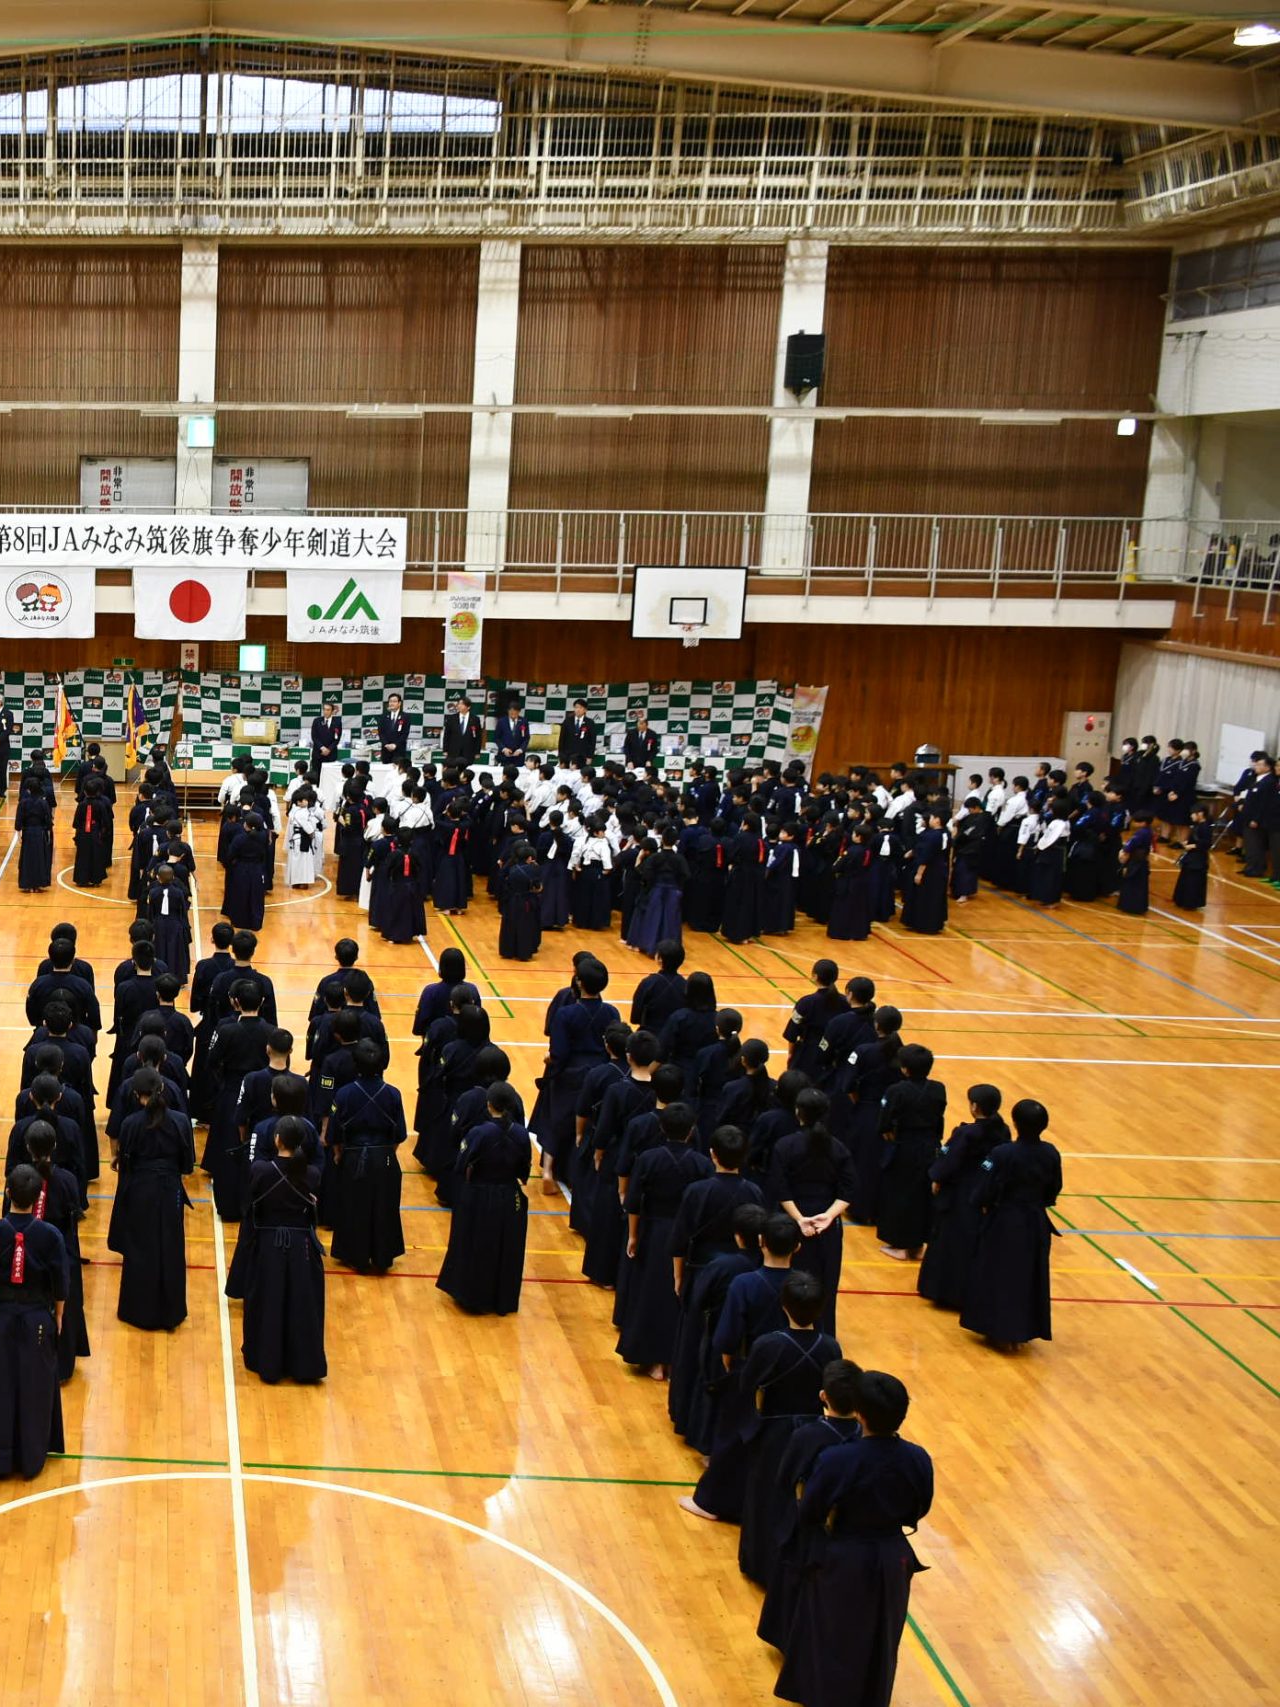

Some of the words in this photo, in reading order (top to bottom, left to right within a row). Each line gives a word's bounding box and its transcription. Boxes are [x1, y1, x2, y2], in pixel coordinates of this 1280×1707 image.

[113, 465, 123, 502] 非常口
[245, 466, 254, 502] 非常口
[307, 577, 380, 620] JA
[309, 625, 380, 636] JAみなみ筑後
